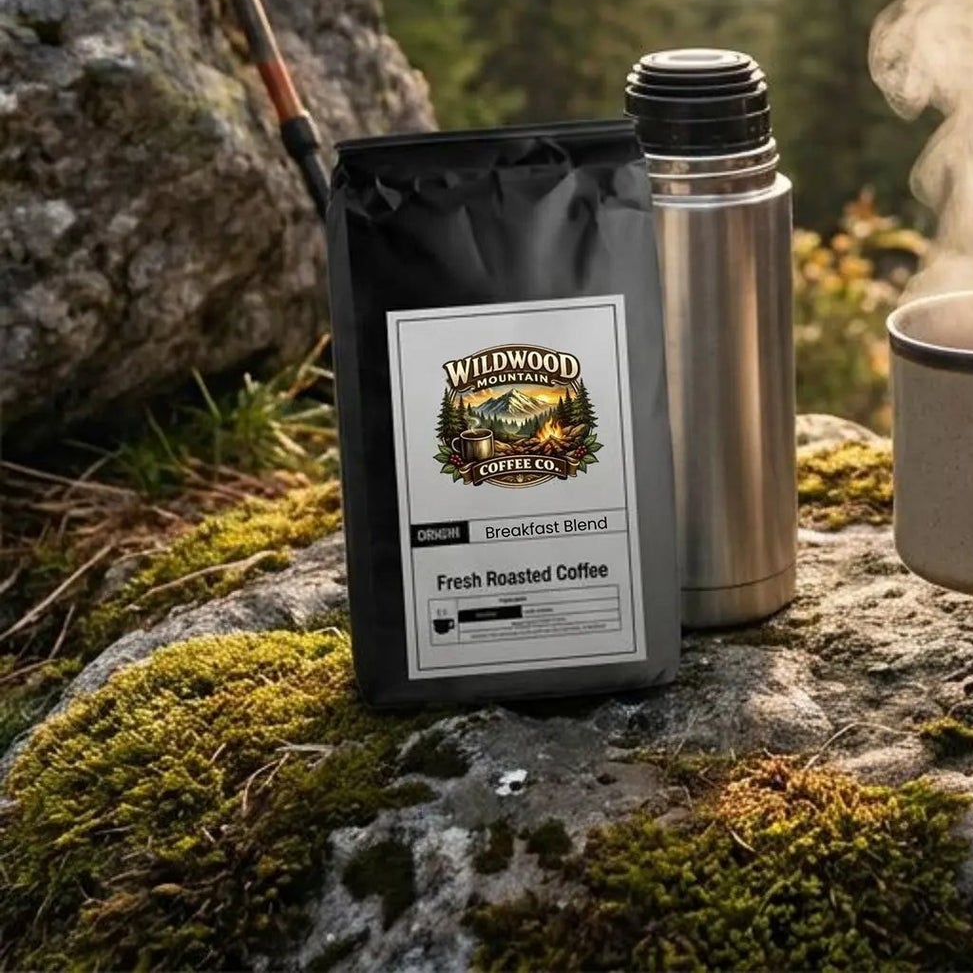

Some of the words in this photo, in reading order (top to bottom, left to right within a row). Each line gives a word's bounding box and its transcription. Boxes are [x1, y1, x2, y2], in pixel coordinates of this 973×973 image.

[445, 350, 580, 387] WILDWOOD
[477, 372, 549, 389] MOUNTAIN
[479, 458, 532, 476] COFFEE
[535, 458, 560, 472] CO.
[485, 520, 560, 539] Breakfast
[564, 516, 608, 533] Blend
[437, 572, 482, 591] Fresh
[486, 566, 552, 587] Roasted
[556, 562, 609, 581] Coffee
